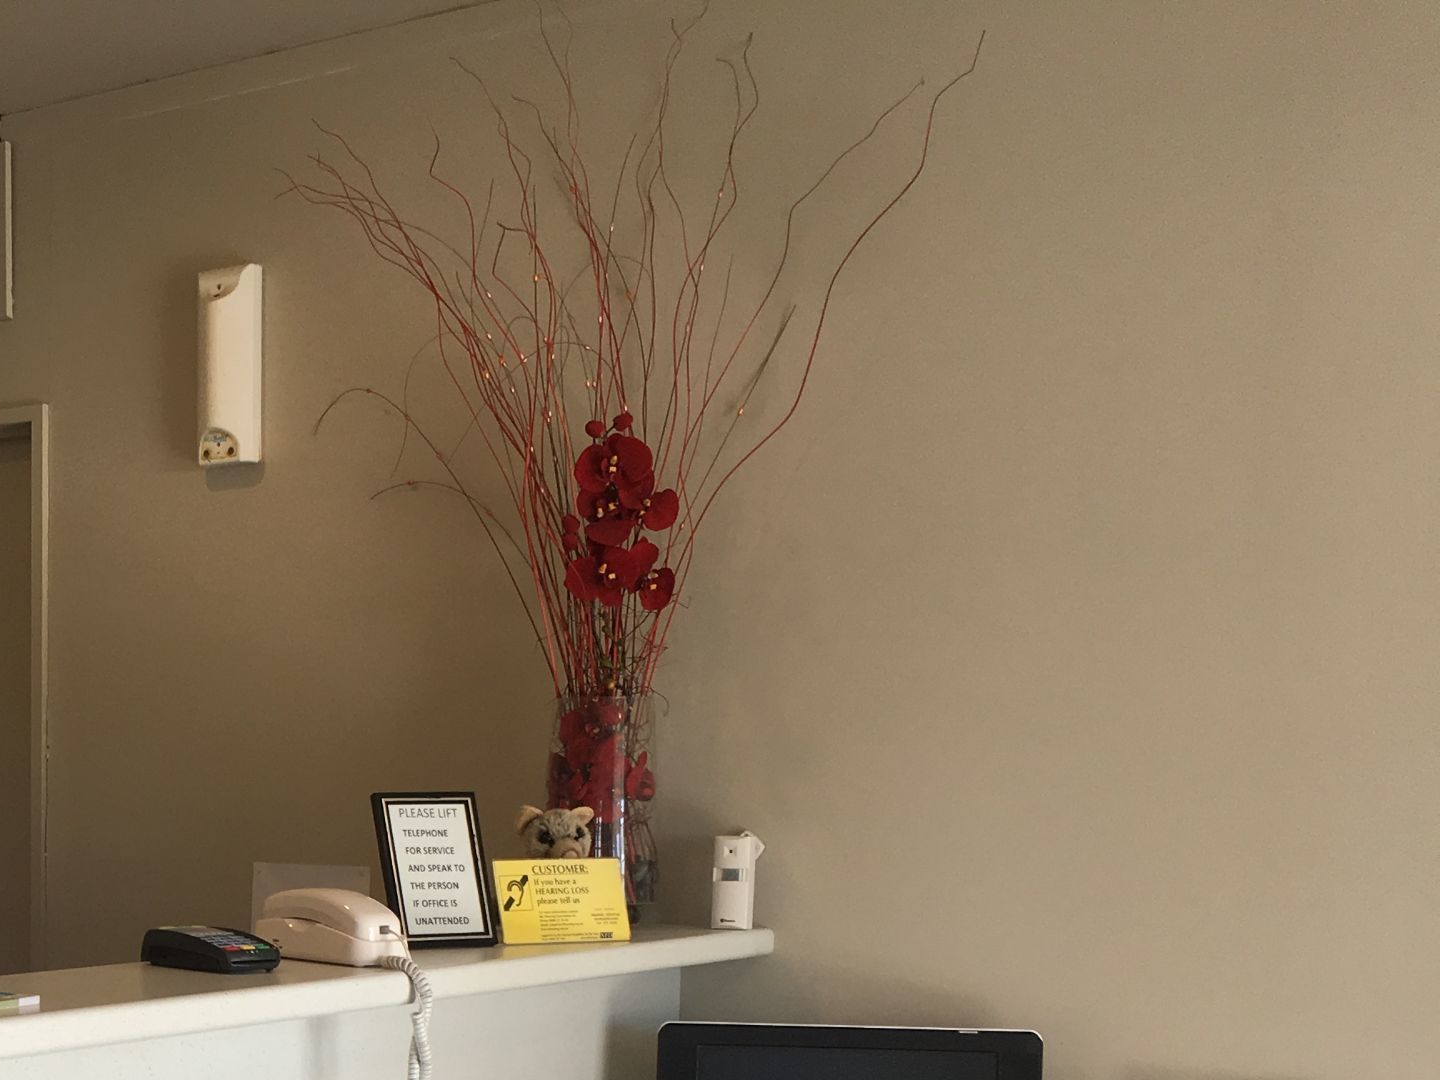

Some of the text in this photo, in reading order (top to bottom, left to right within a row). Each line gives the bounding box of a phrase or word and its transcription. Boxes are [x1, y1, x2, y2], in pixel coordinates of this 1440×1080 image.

[398, 808, 458, 818] PLEASE LIFT
[402, 829, 448, 838] TELEPHONE
[405, 846, 455, 855] FOR SERVICE
[408, 864, 466, 873] AND SPEAK TO
[531, 864, 589, 874] CUSTOMER:
[410, 882, 459, 890] THE PERSON
[533, 878, 541, 886] If
[541, 880, 554, 888] you
[554, 878, 571, 886] have
[535, 886, 590, 895] HEARING LOSS
[421, 899, 448, 907] OFFICE
[450, 899, 458, 907] IS
[537, 897, 558, 907] please
[415, 916, 470, 925] UNATTENDED
